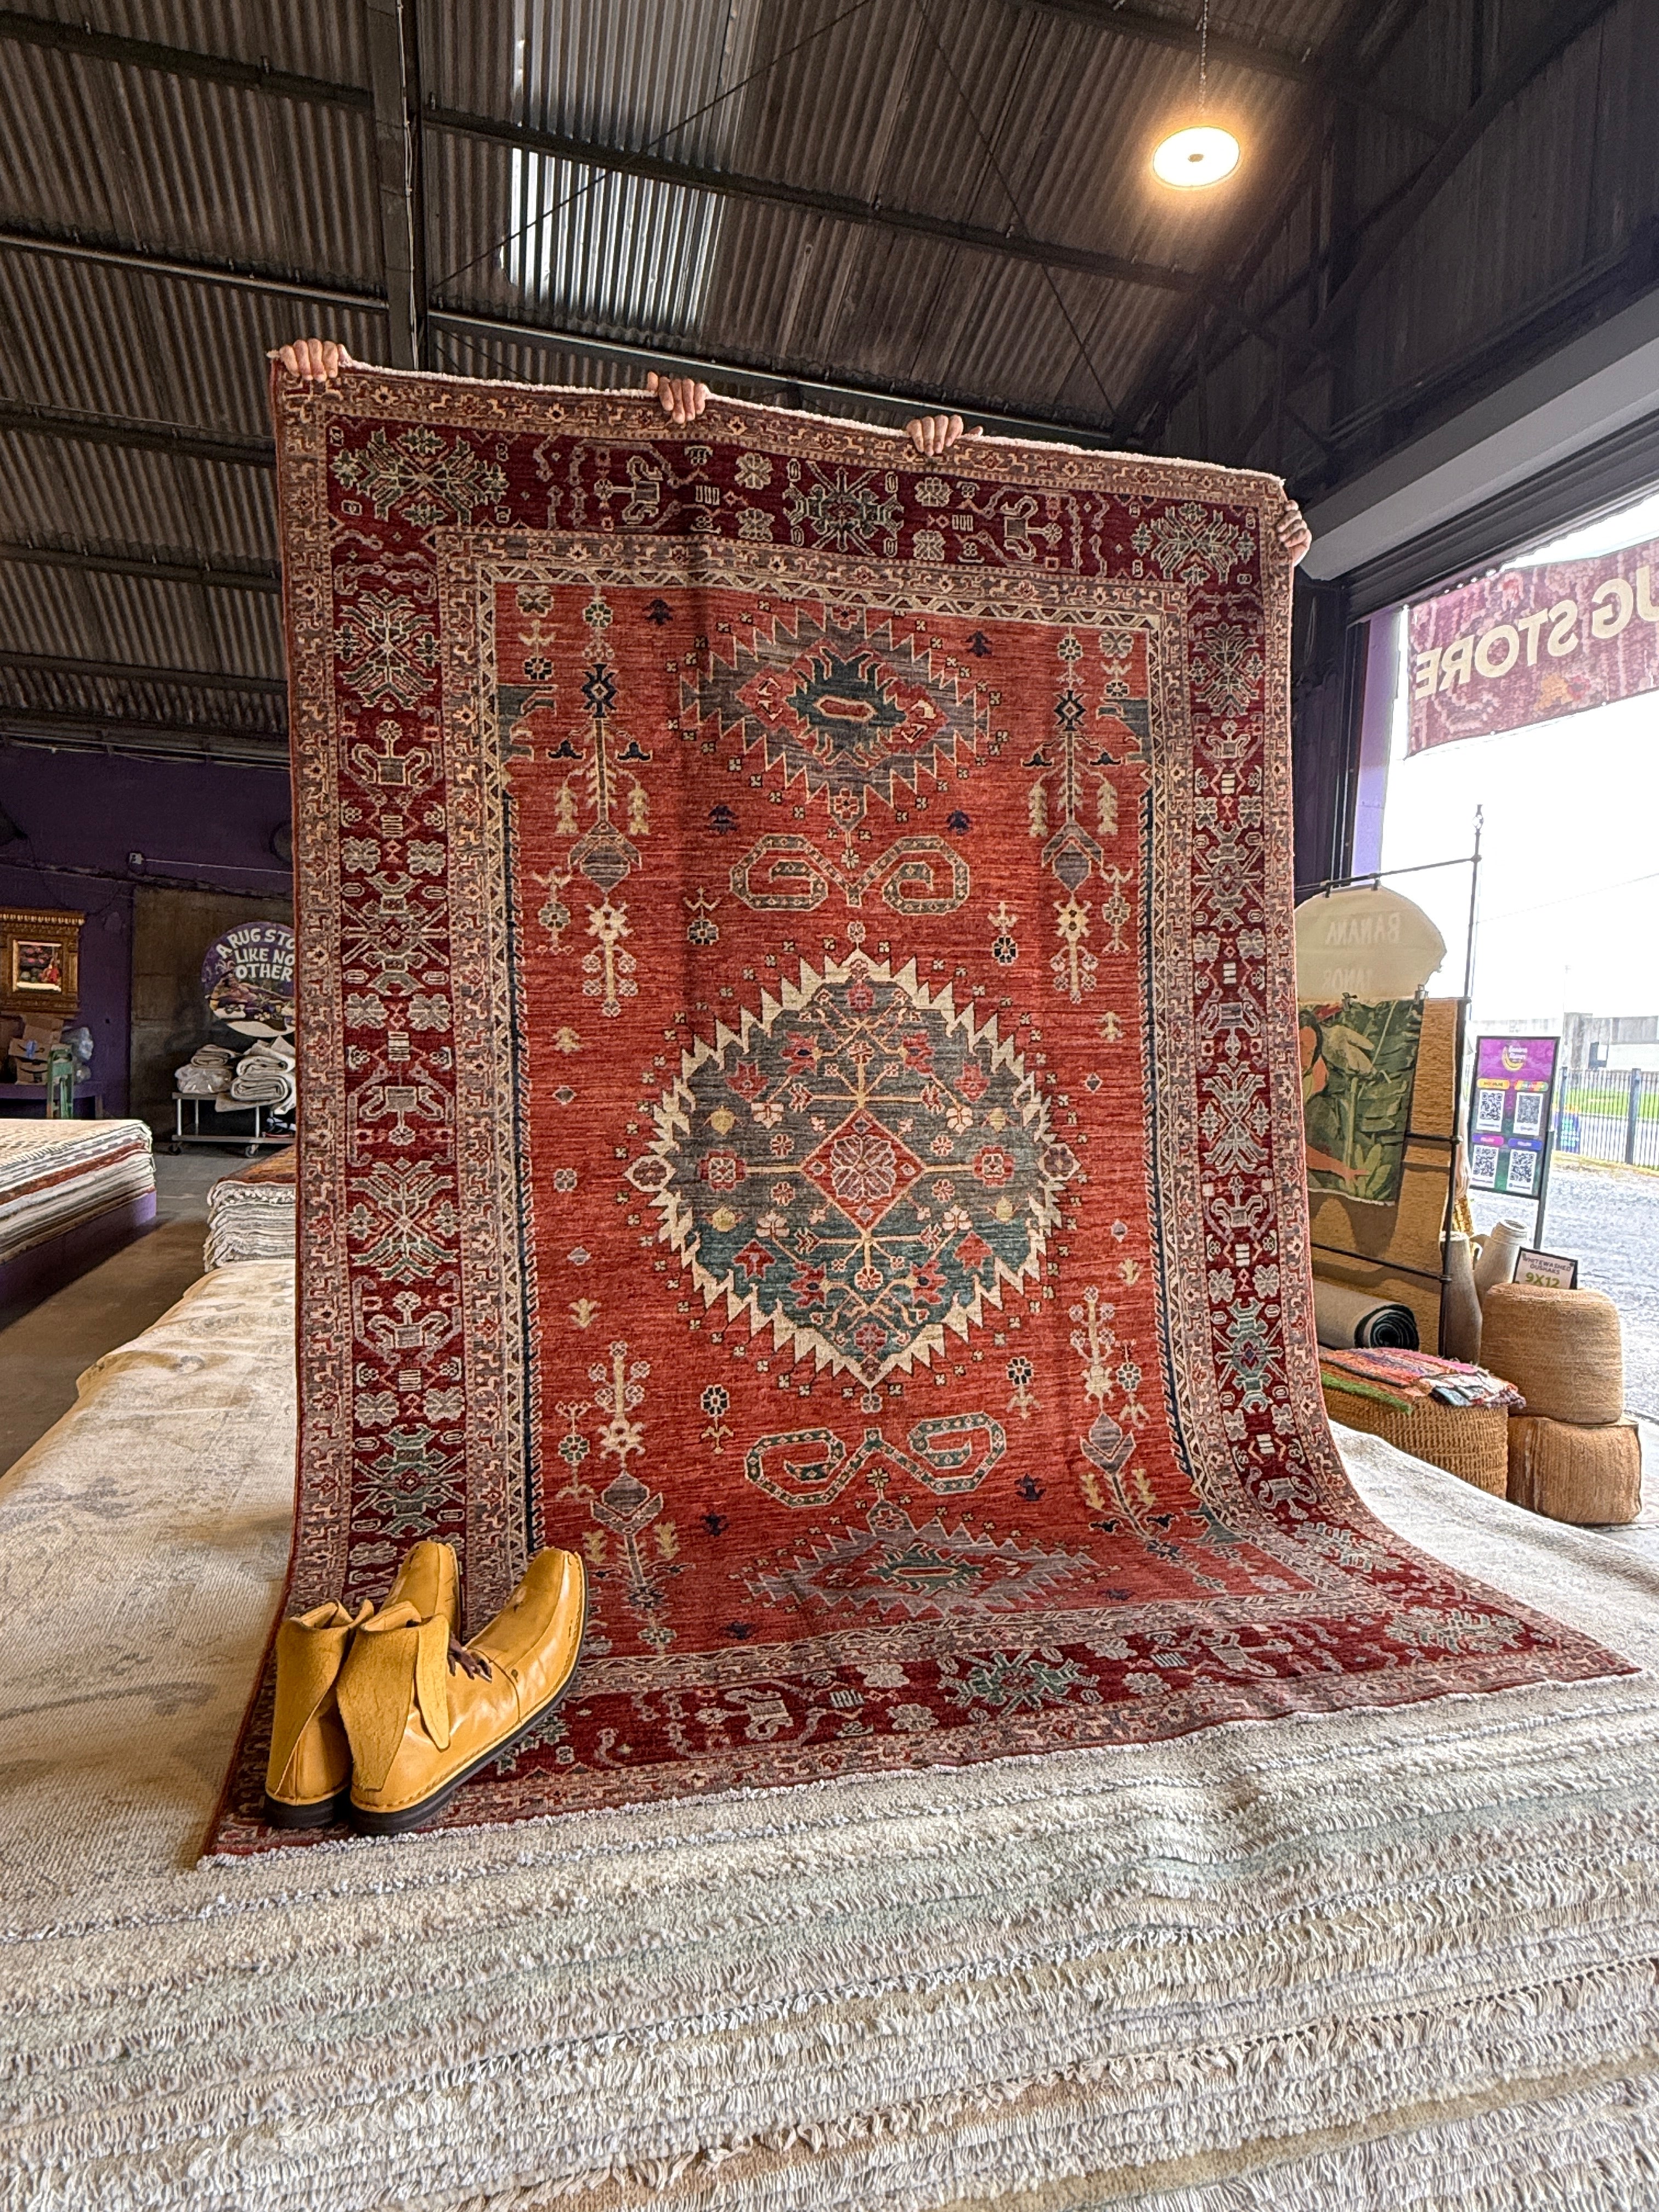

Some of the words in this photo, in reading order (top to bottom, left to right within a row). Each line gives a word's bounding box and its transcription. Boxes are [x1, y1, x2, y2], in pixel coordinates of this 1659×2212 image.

[215, 944, 233, 959] A
[227, 928, 261, 949] RUG
[234, 948, 270, 963] LIKE
[273, 949, 295, 966] NO
[236, 964, 293, 982] OTHER
[1525, 1272, 1560, 1288] 9X12
